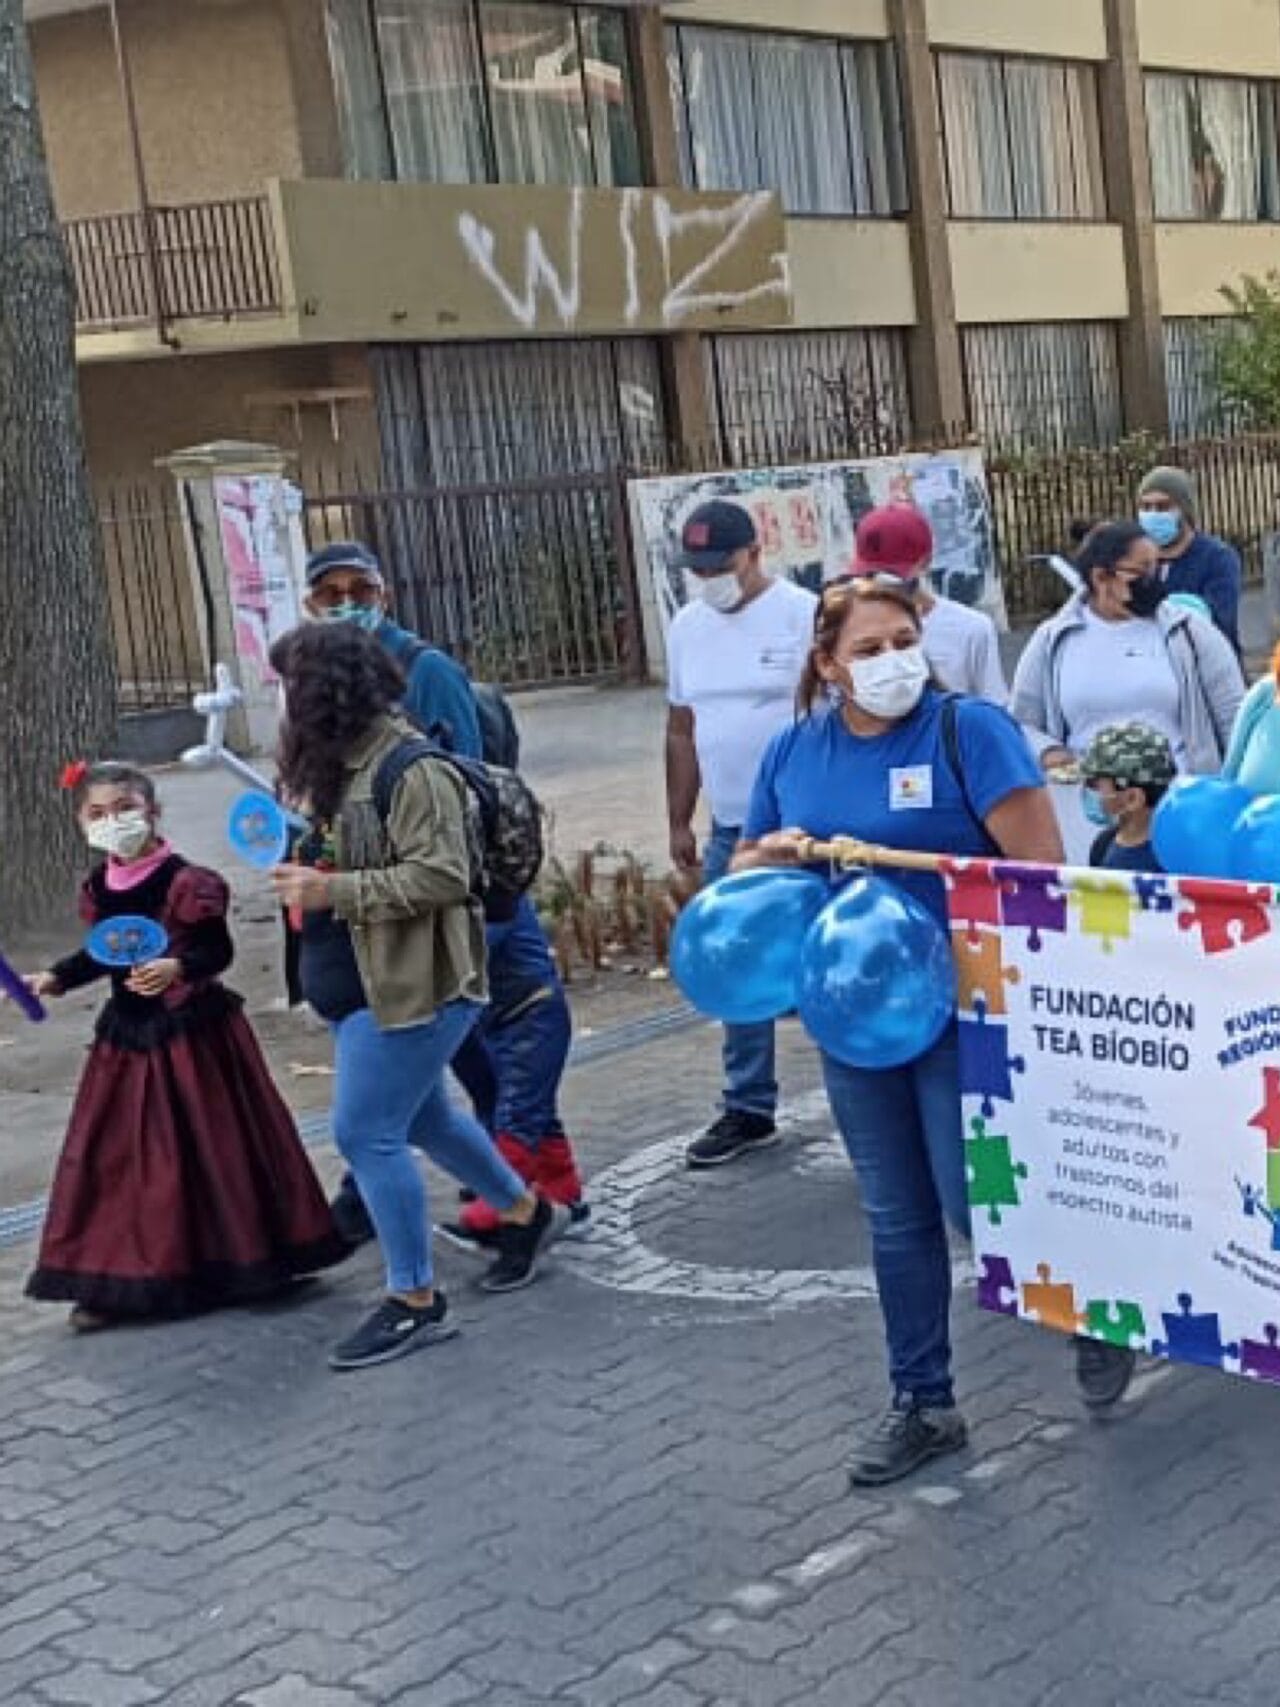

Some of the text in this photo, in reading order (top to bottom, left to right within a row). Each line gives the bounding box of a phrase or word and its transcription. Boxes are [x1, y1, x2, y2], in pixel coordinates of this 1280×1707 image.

[1030, 983, 1195, 1031] FUNDACIÓN
[1033, 1024, 1189, 1071] TEA BÍOBÍO
[1062, 1137, 1168, 1169] adultos con
[1169, 1130, 1181, 1149] y
[1056, 1162, 1180, 1201] trastornos del
[1046, 1190, 1193, 1232] espectro autista
